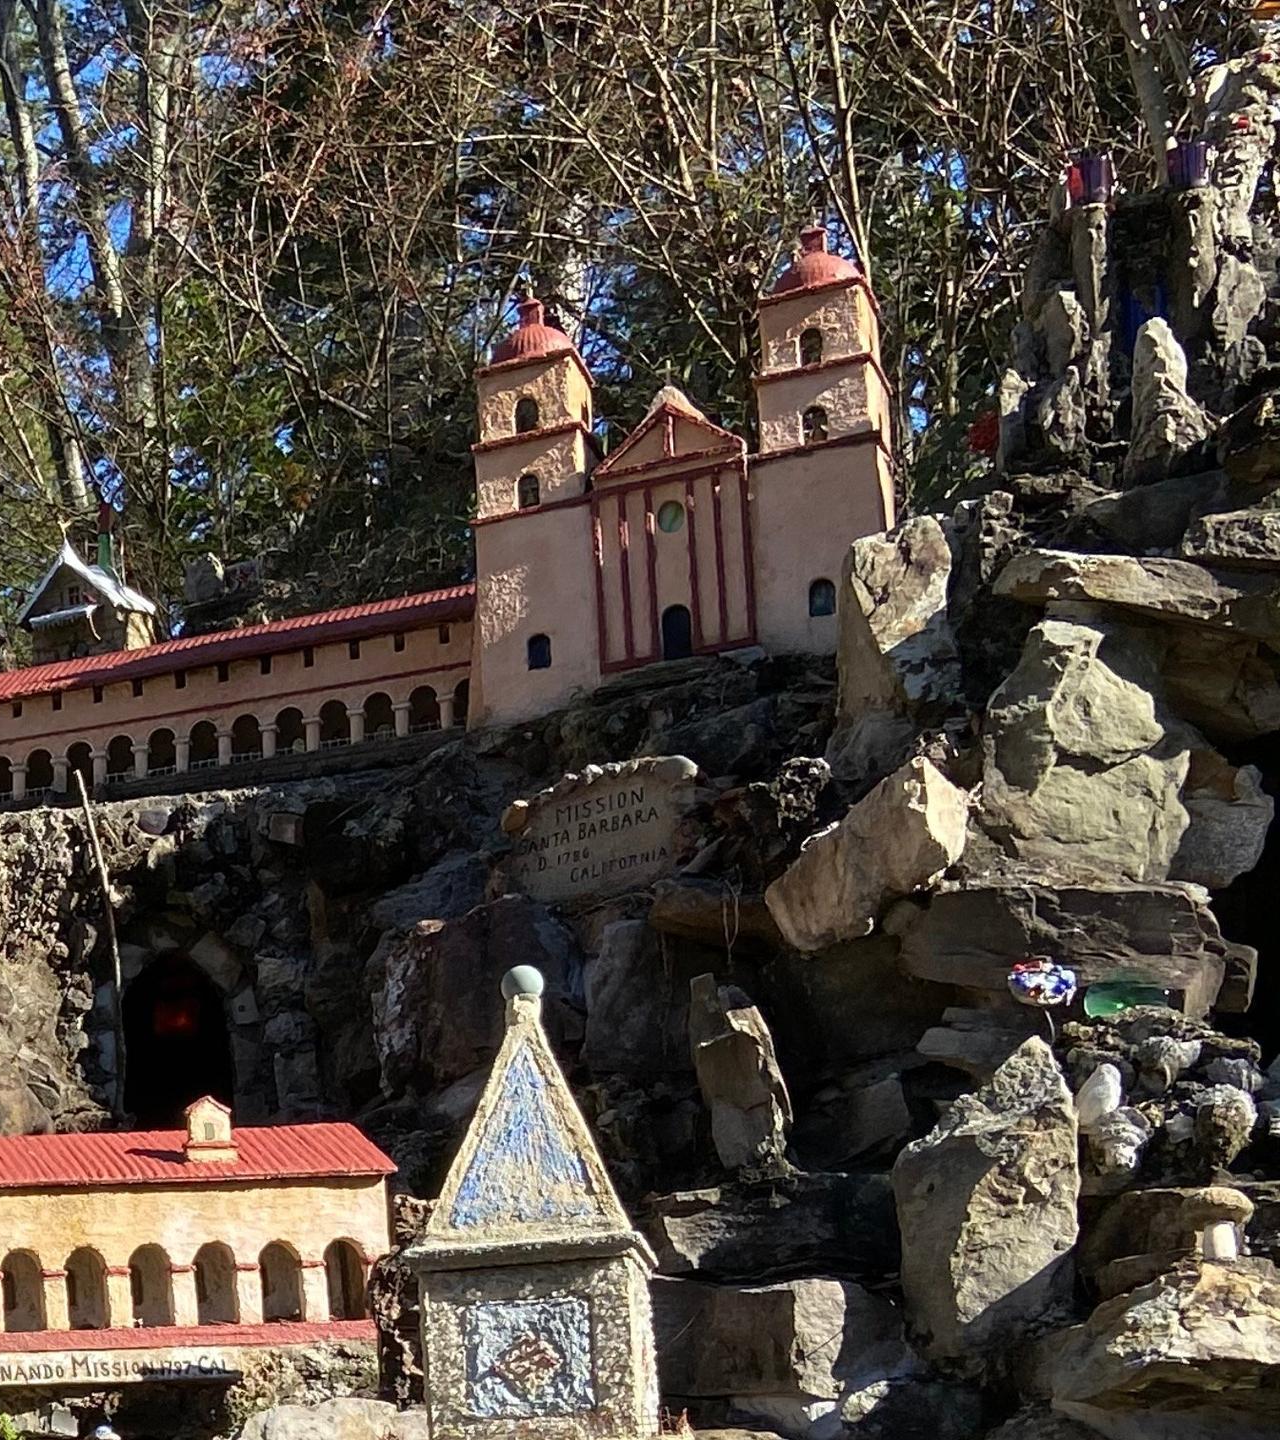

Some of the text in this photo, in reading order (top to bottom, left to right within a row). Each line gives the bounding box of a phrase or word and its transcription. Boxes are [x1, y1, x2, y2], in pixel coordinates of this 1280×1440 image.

[555, 786, 644, 825] MISSION
[520, 806, 659, 855] SANTA BARBARA
[570, 846, 668, 883] CALIFORNIA
[70, 1354, 154, 1379] MISSION
